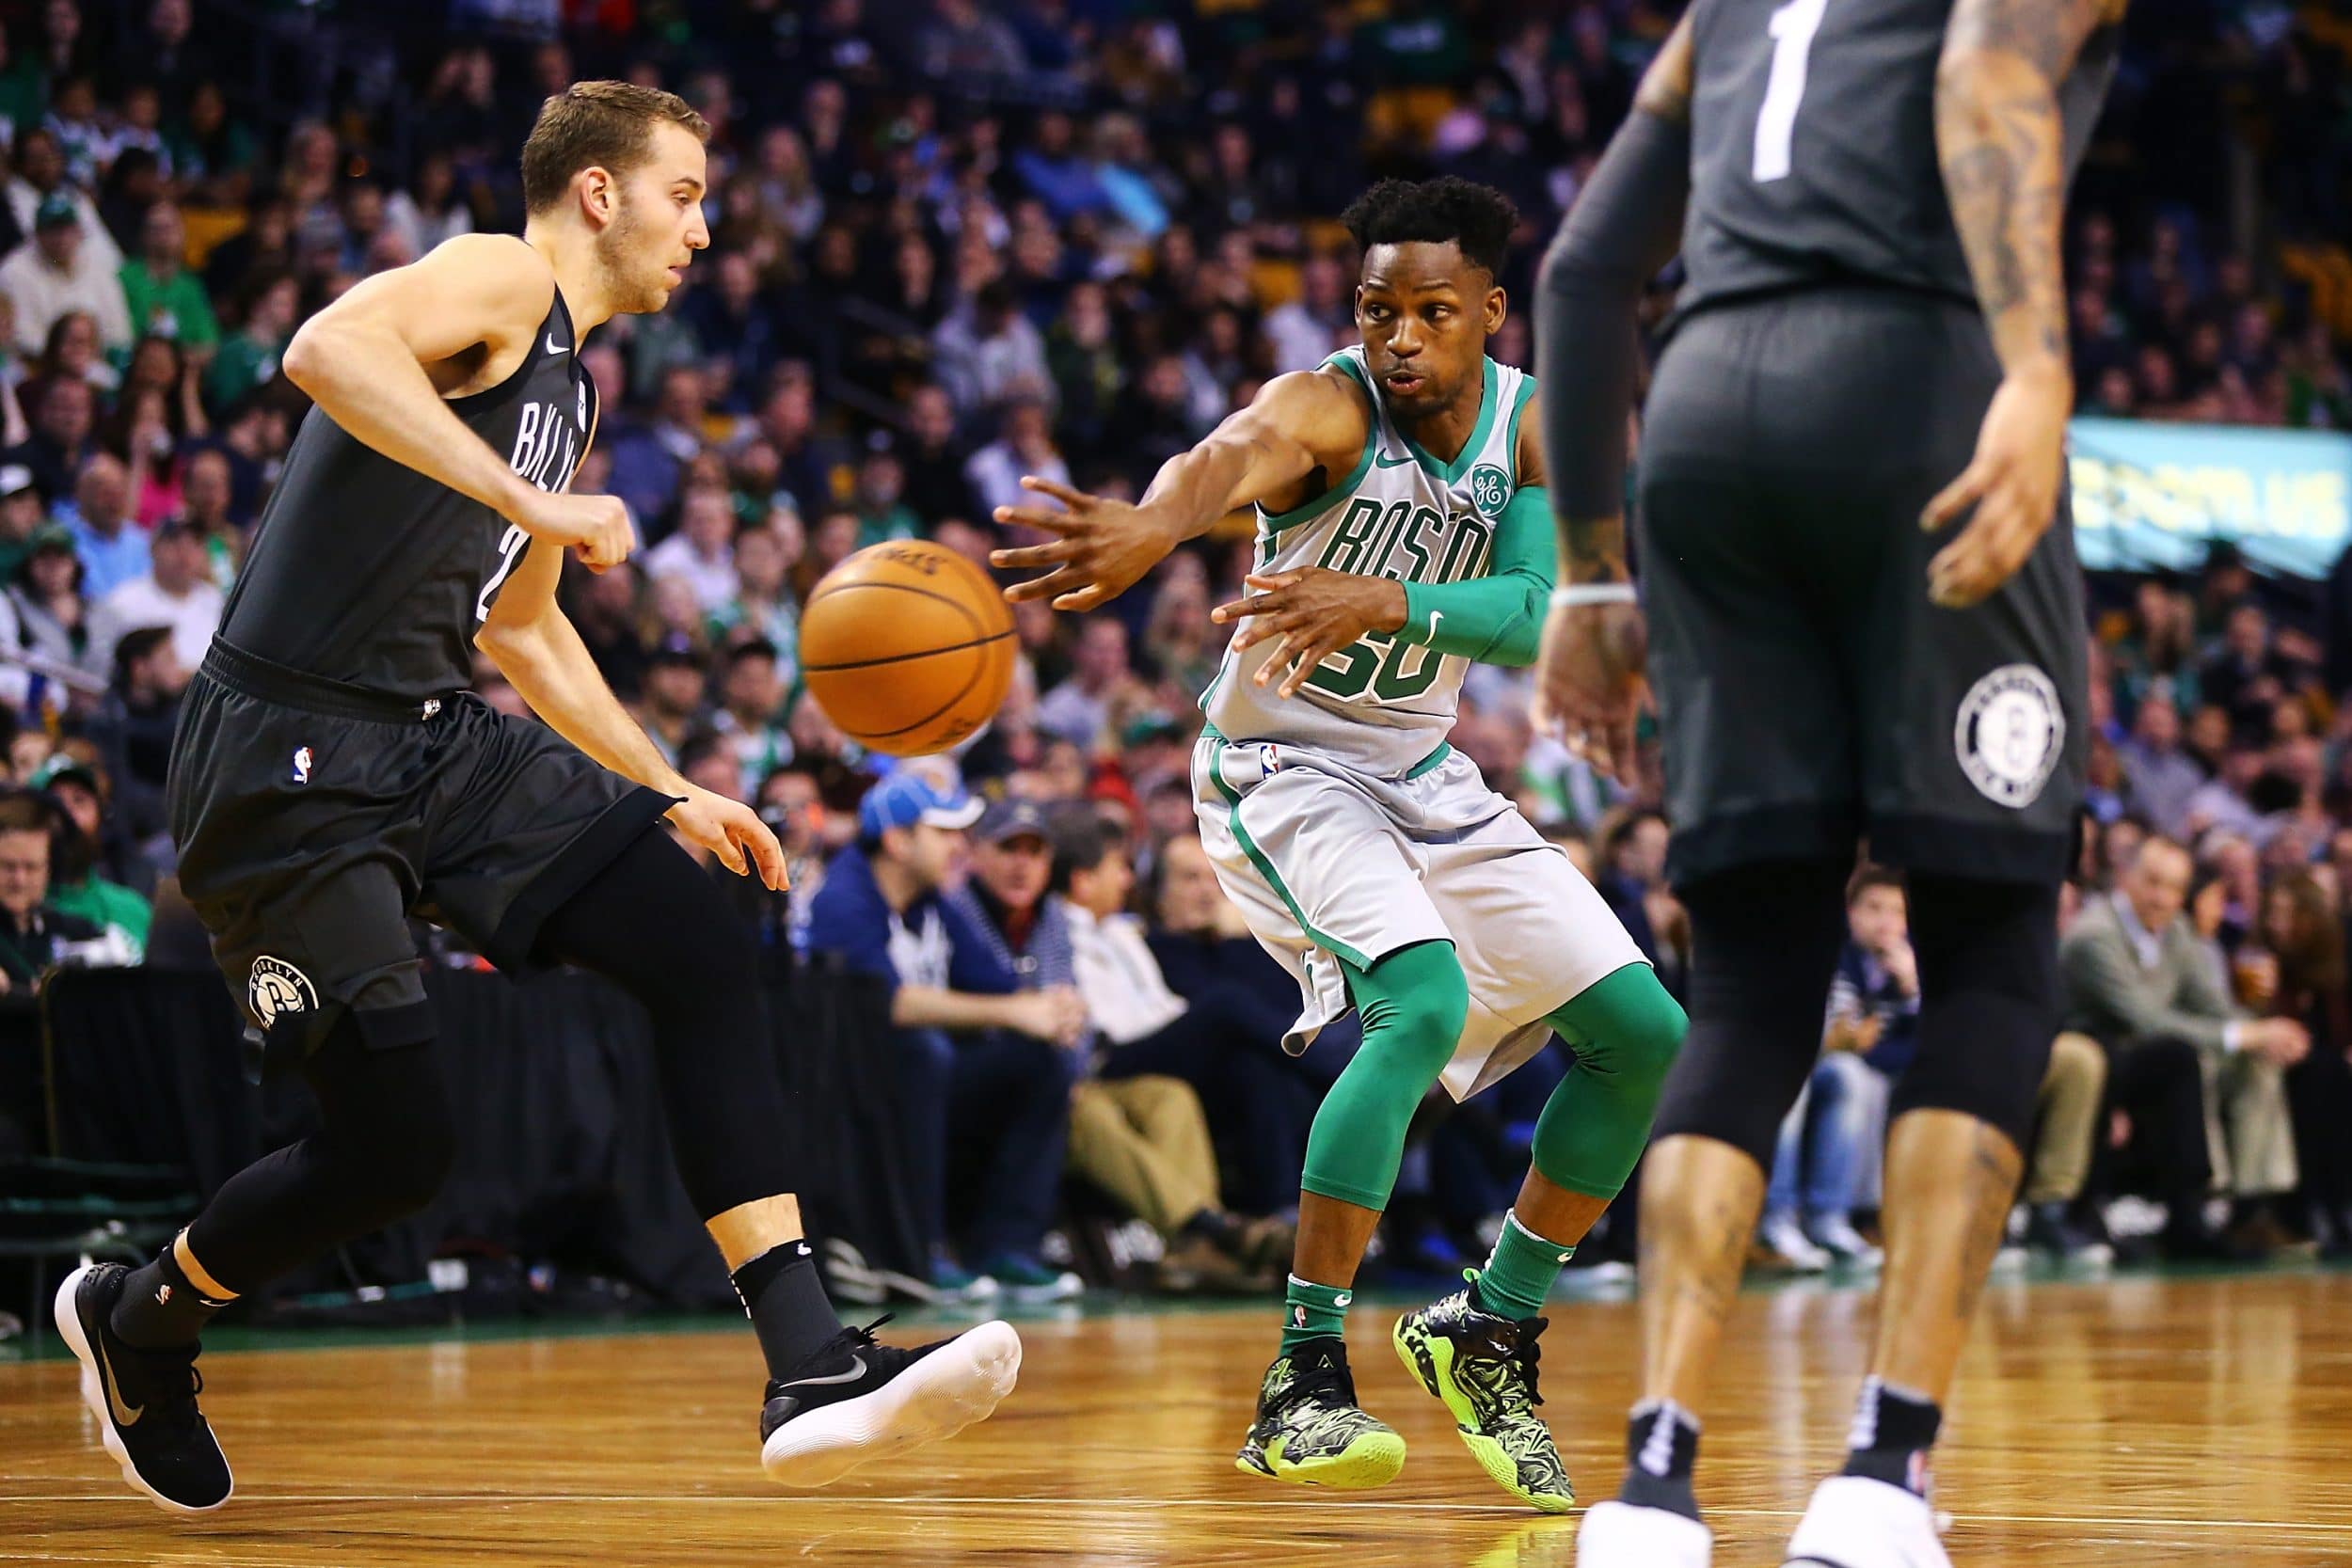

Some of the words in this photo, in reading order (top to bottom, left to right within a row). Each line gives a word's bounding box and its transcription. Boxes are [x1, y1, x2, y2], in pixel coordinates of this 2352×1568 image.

[1752, 0, 1829, 182] 1
[1314, 495, 1491, 584] BOSO
[251, 960, 304, 991] BROOKLYN
